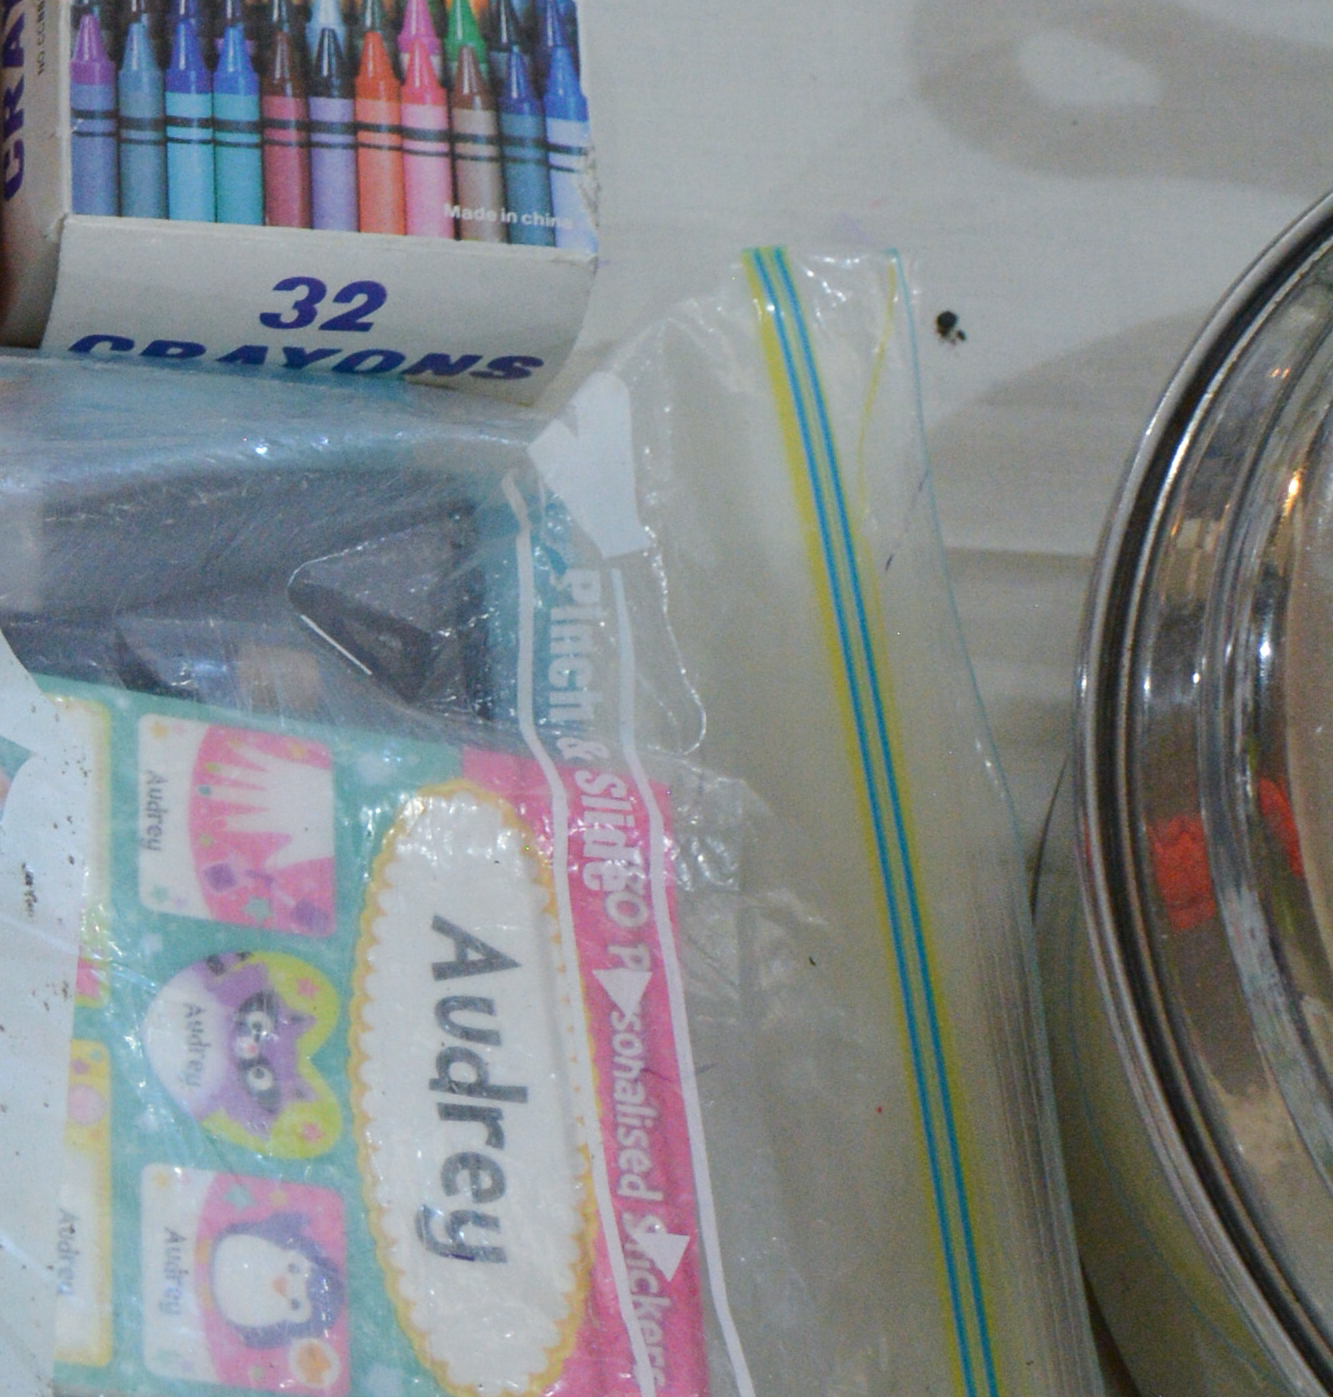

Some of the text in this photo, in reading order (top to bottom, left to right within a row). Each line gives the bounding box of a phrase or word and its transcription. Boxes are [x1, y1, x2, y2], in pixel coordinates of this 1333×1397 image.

[443, 204, 574, 230] Made in china
[259, 276, 388, 332] 32
[549, 567, 607, 723] Pinch
[556, 735, 610, 762] &
[142, 769, 168, 852] Audrey
[574, 770, 641, 893] Slide
[183, 1005, 207, 1089] Audrey
[414, 912, 530, 1265] Audrey
[159, 1227, 188, 1316] Audrey
